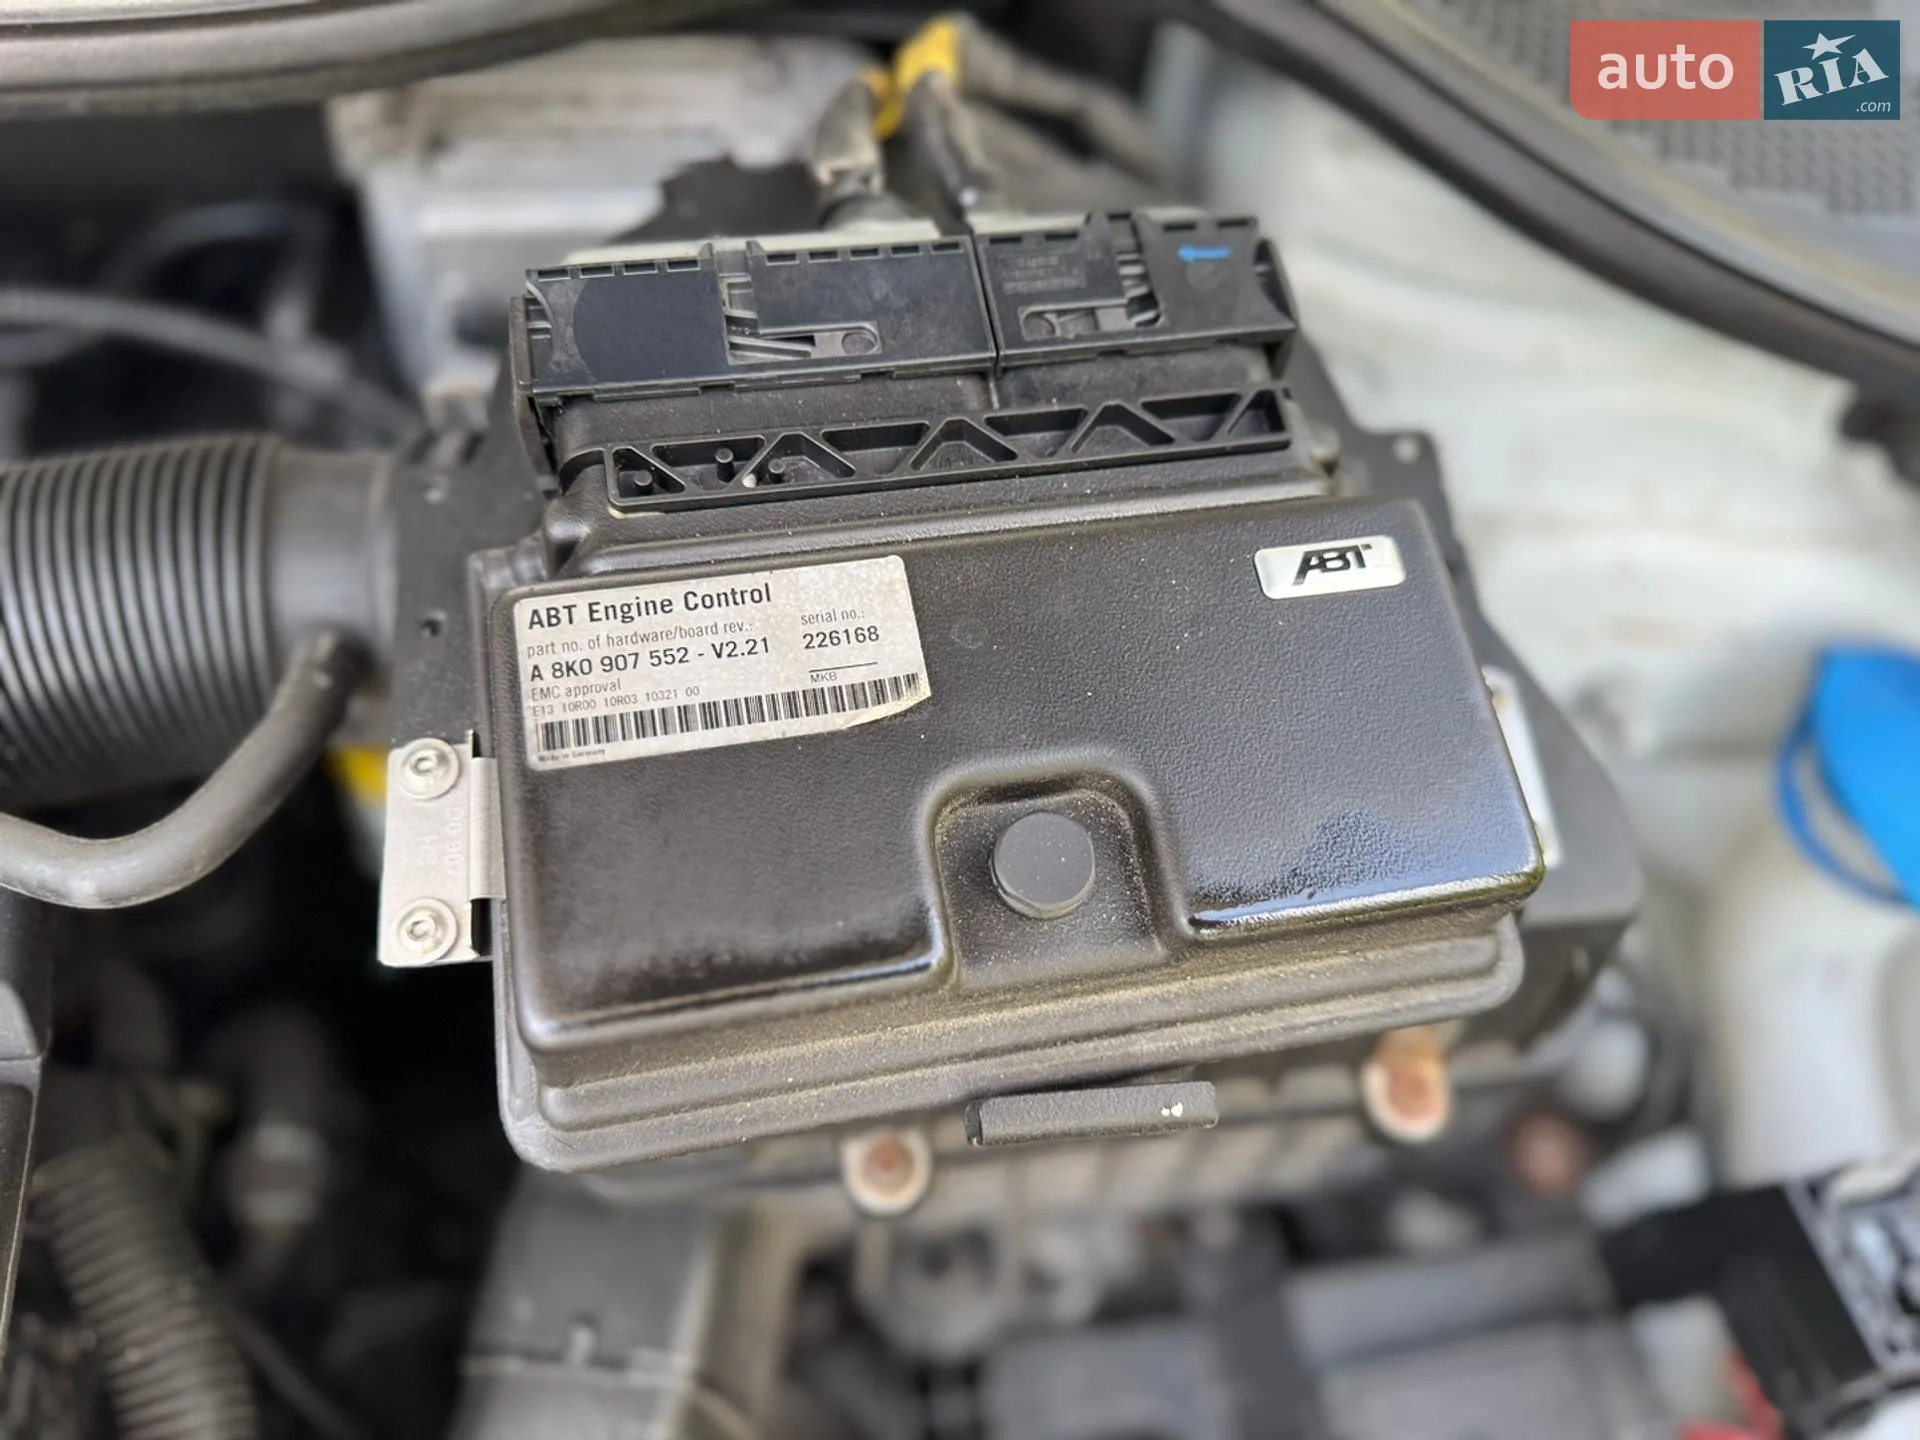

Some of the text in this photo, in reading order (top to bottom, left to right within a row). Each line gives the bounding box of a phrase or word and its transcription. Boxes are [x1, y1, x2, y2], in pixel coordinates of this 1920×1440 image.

[1292, 543, 1372, 586] ABT
[528, 582, 771, 629] ABT Engine Control
[801, 608, 838, 625] serial
[527, 642, 557, 659] part
[562, 640, 583, 653] no.
[588, 635, 601, 650] of
[606, 622, 719, 647] hardware/board
[803, 625, 880, 650] 226168
[530, 664, 544, 682] A
[600, 652, 640, 673] 907
[650, 646, 690, 667] 552
[711, 637, 769, 660] V2.21
[810, 671, 838, 683] MKB
[531, 678, 621, 702] EMC approval
[604, 695, 639, 709] 10R03
